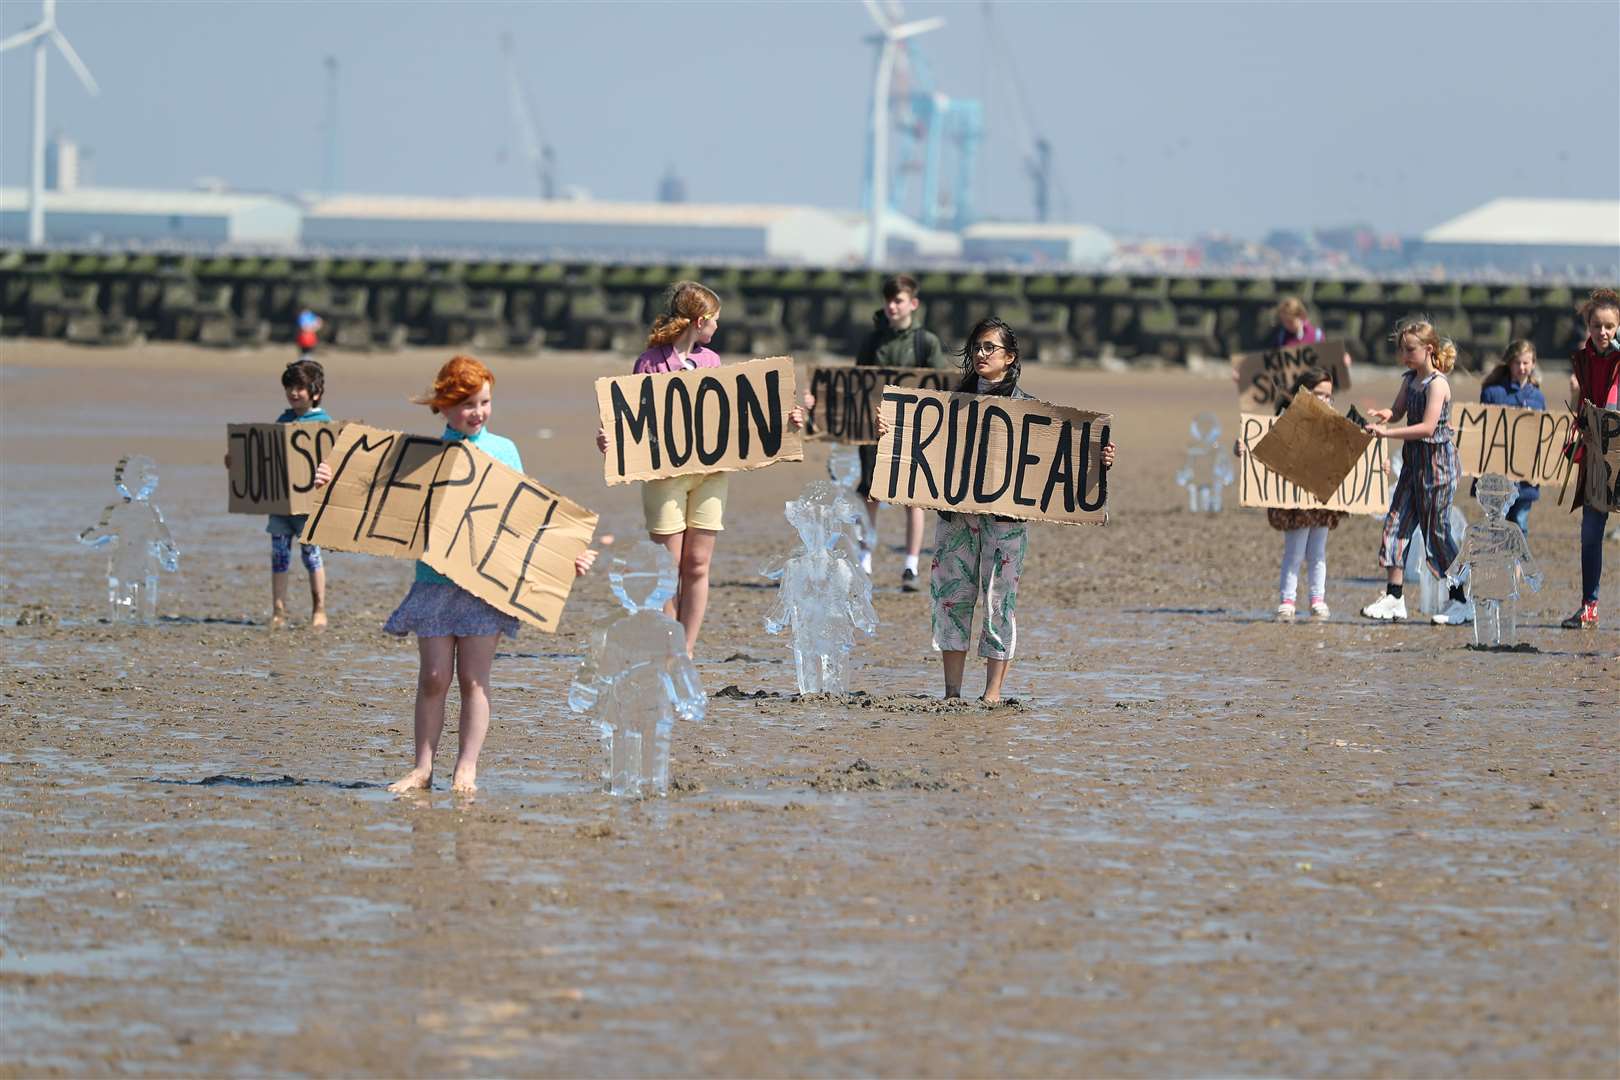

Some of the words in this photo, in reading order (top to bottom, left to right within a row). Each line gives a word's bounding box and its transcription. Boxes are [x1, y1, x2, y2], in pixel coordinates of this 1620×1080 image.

[1264, 346, 1318, 369] KING
[230, 427, 344, 504] JOHNSO
[610, 370, 782, 475] MOON
[882, 392, 1111, 513] TRUDEAU
[1456, 408, 1571, 480] MACRO
[307, 434, 558, 622] MERKEL
